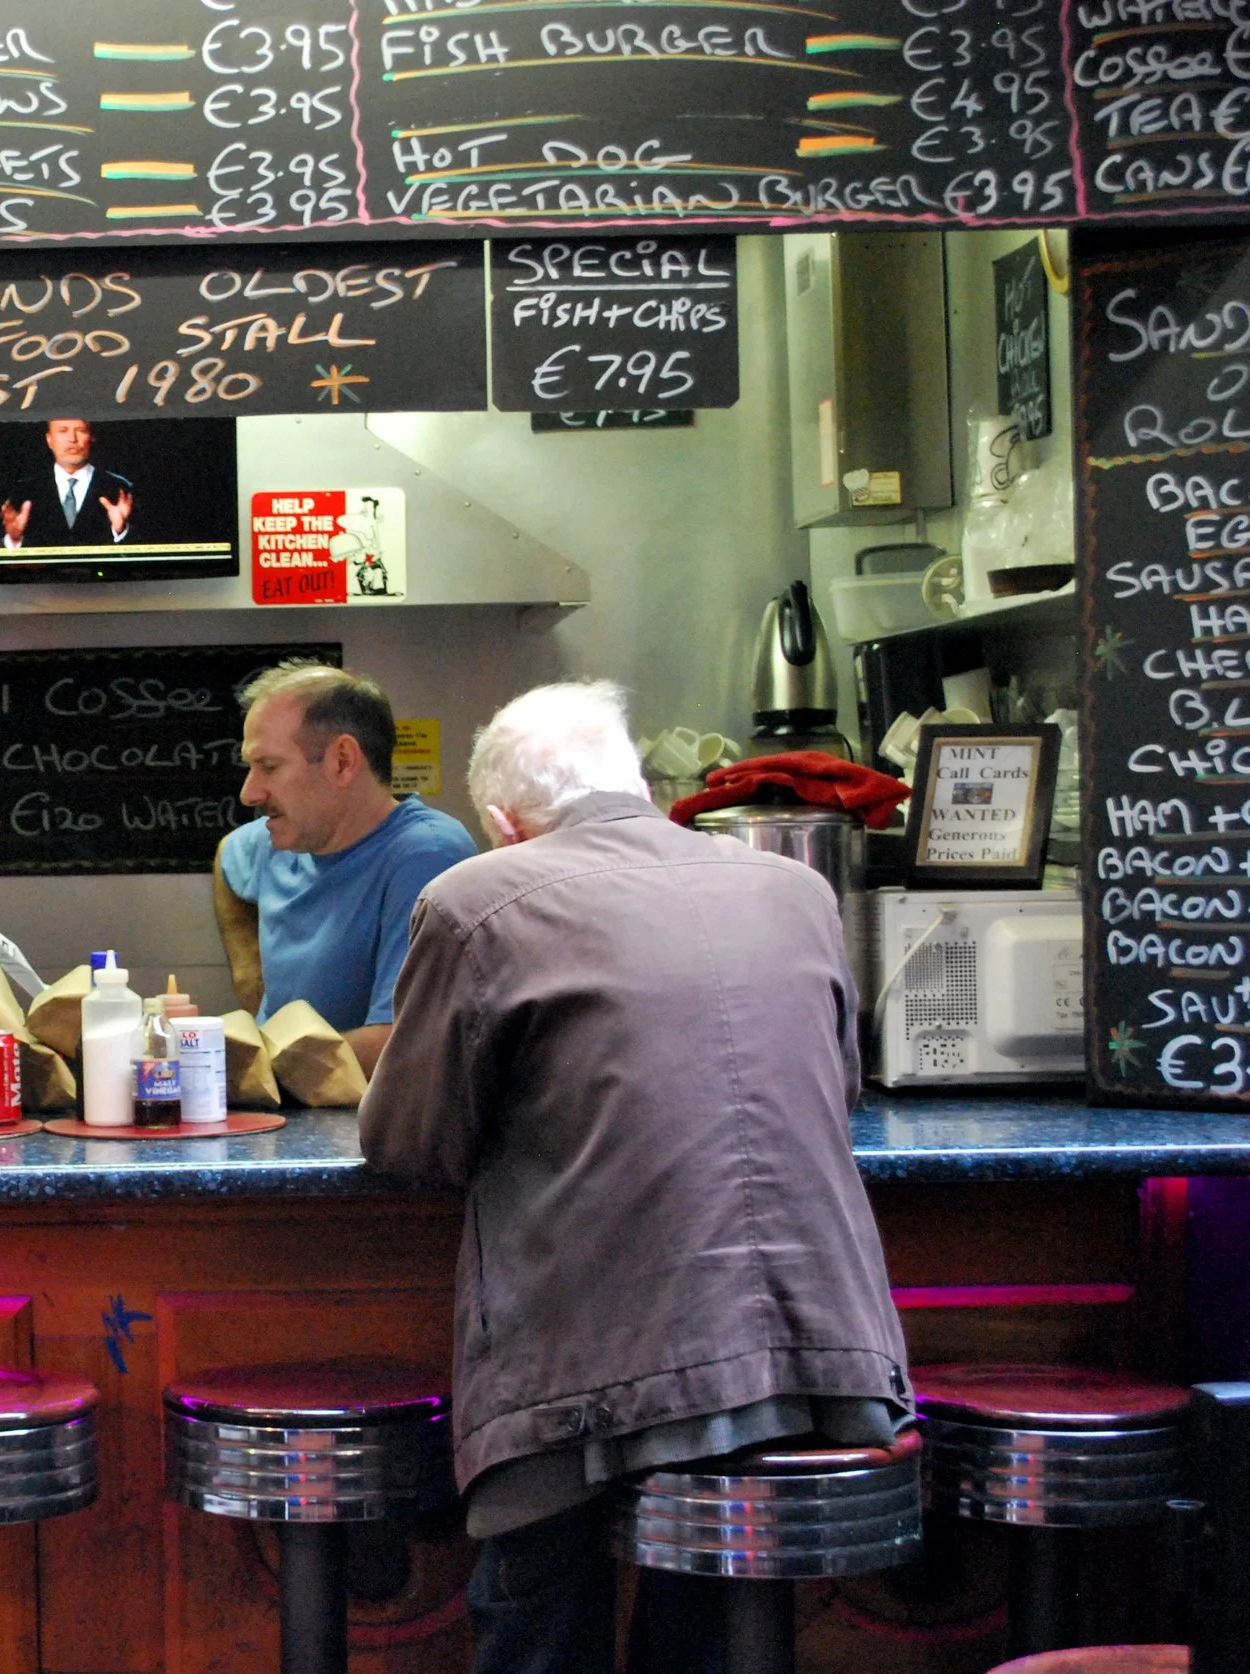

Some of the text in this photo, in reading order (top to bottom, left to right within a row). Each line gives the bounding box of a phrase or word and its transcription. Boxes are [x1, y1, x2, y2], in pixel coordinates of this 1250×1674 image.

[202, 19, 347, 74] €3.95
[540, 22, 796, 59] BURGER
[902, 26, 1045, 71] €3.95
[203, 84, 342, 130] €3.95
[1093, 92, 1202, 137] TEA
[392, 120, 1059, 172] HOT DOG €3.95
[207, 143, 346, 195] €3.95
[1095, 152, 1214, 193] CANS
[758, 175, 945, 216] BURGER
[200, 261, 458, 308] OLDEST
[178, 313, 375, 356] STALL
[115, 358, 262, 405] 1980
[532, 345, 694, 399] €7.95
[253, 515, 334, 532] KEEP THE
[272, 498, 315, 514] HELP
[258, 533, 329, 550] KITCHEN
[263, 570, 335, 599] EAT OUT!
[1143, 648, 1250, 680] CHE
[937, 766, 1029, 779] Call Cards
[950, 747, 1000, 760] MINT
[929, 828, 1006, 841] Generous
[931, 808, 1016, 821] WANTED
[1106, 795, 1192, 838] HAM
[926, 847, 1018, 860] Prices Paid
[1098, 846, 1230, 880] BACON
[1102, 886, 1242, 924] BACON
[1107, 929, 1243, 968] BACON
